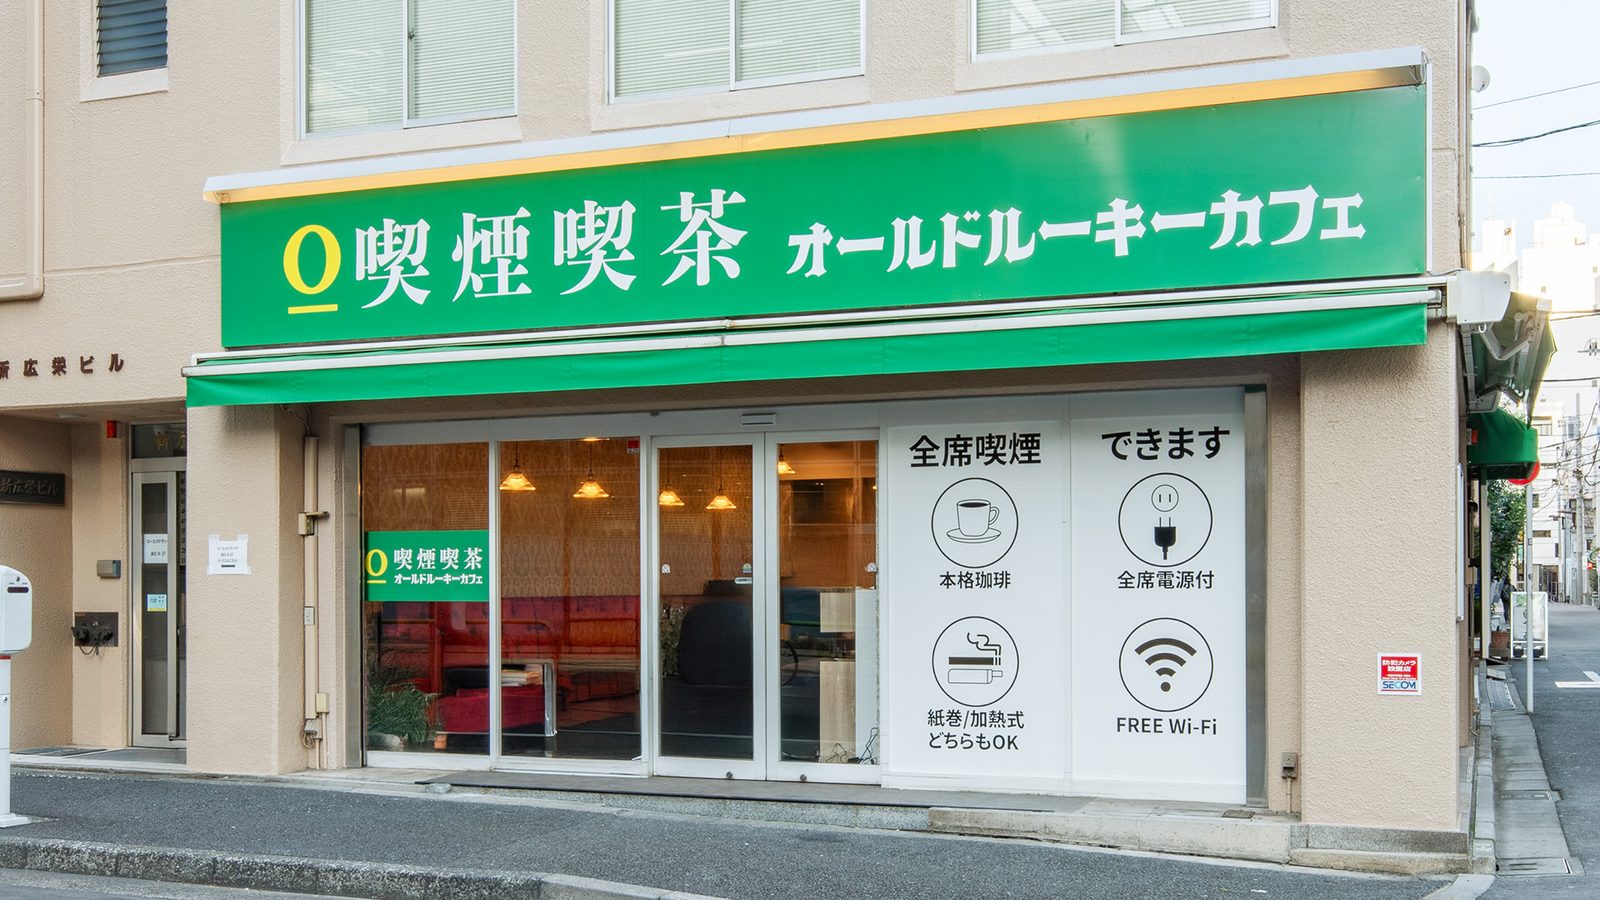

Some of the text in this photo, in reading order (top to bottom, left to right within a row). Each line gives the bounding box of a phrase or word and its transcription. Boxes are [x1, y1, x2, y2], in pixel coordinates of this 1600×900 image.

[354, 188, 748, 309] 喫煙喫茶
[786, 184, 1367, 278] オールドルーキーカフェ
[0, 353, 125, 380] 新広栄ビル
[909, 426, 1231, 467] 全席喫煙 できます
[393, 547, 483, 570] 喫煙喫茶
[394, 573, 483, 585] オールドルーキーカフェ
[939, 570, 1011, 590] 本格珈琲
[1117, 570, 1215, 590] 全席電源付
[1382, 681, 1416, 689] SECOM
[927, 708, 1025, 730] 紙巻/加熱式
[1116, 717, 1218, 735] FREE Wi-Fi
[928, 731, 1019, 750] どちらもOK
